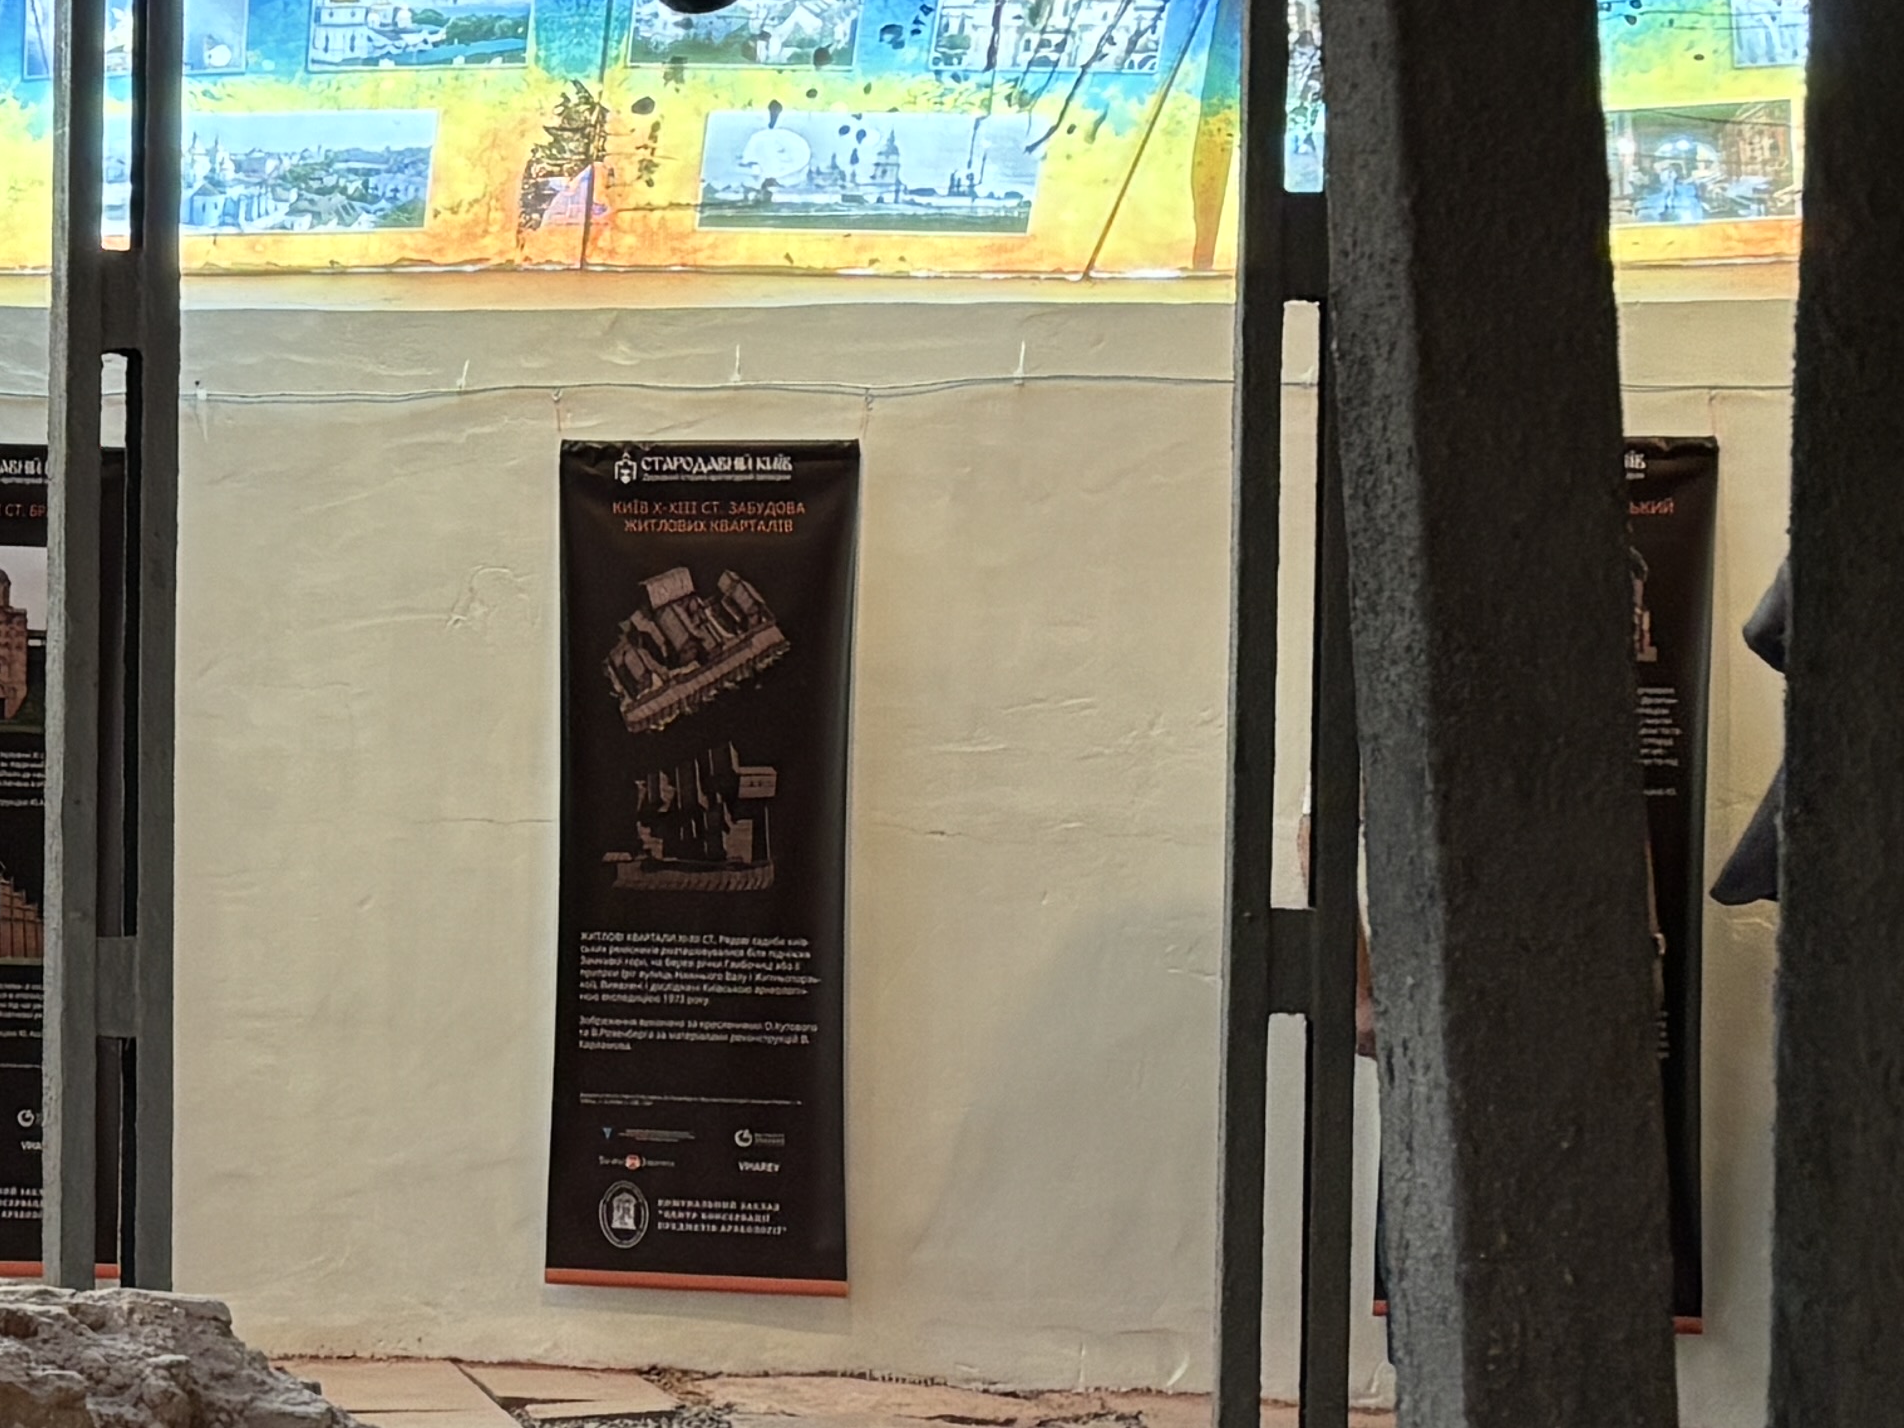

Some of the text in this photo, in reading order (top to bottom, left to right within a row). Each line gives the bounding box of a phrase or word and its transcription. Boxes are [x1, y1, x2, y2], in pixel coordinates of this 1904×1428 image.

[641, 454, 793, 474] СТАРОДАВНІЙ КИЇВ
[612, 499, 649, 514] КИЇВ
[728, 502, 806, 517] ЗАБУДОВА
[624, 519, 794, 533] ЖИТЛОВИХ КВАРТАЛІВ
